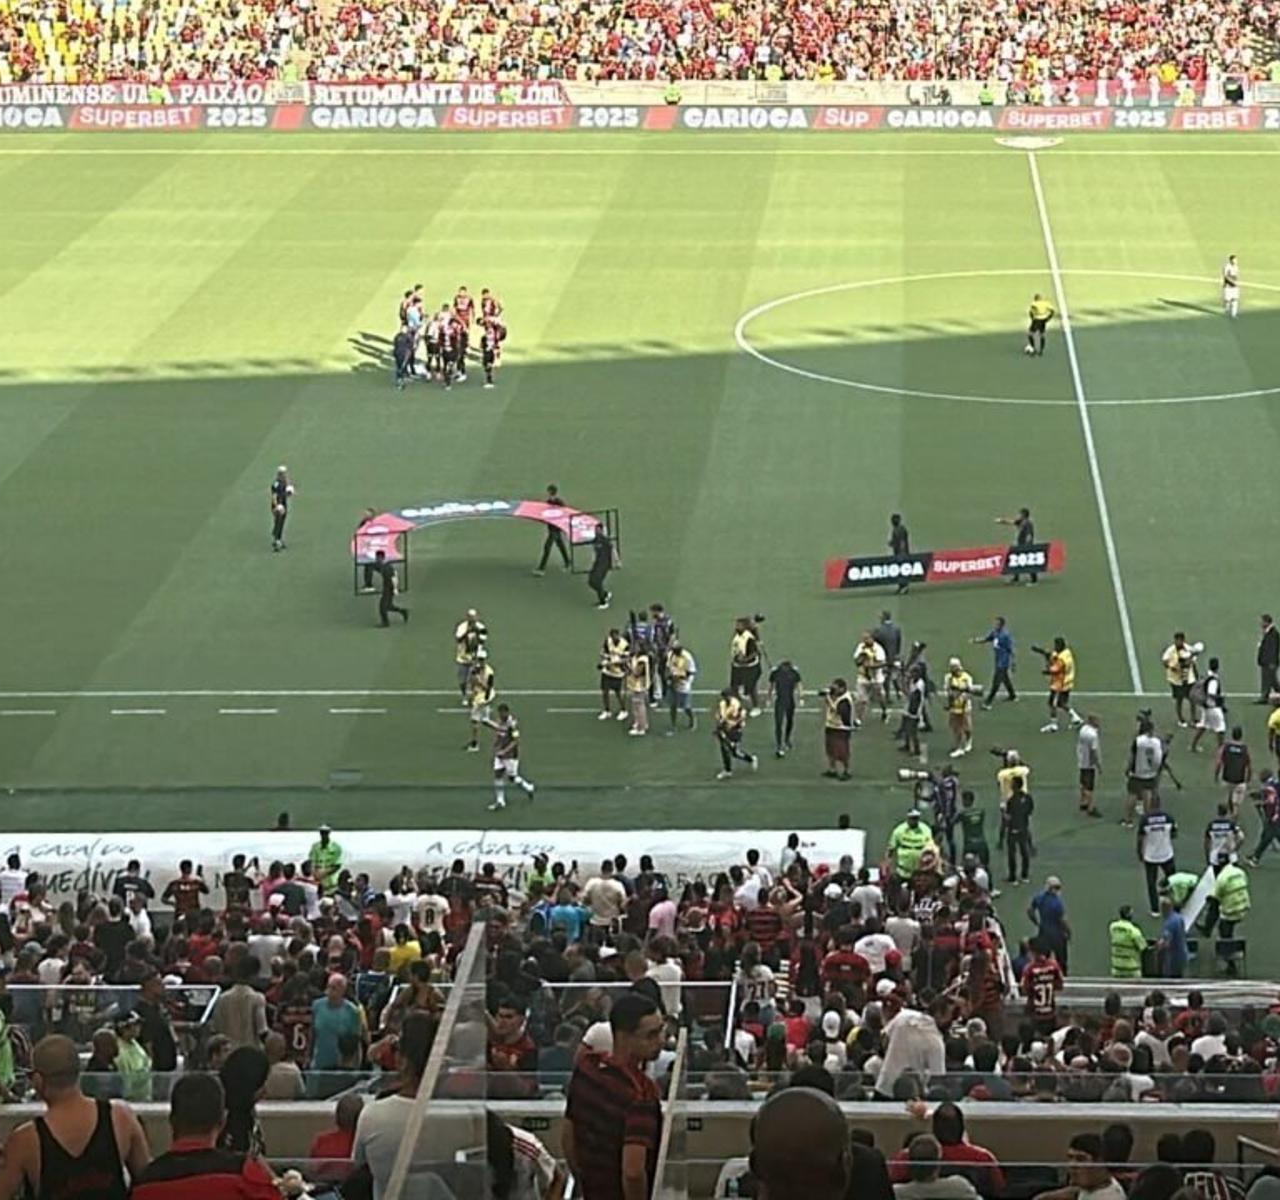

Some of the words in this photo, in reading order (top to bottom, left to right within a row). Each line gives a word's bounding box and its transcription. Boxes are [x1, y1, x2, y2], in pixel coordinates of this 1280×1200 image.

[79, 104, 194, 128] SUPERBET
[206, 106, 267, 128] 2025
[311, 106, 437, 129] CARIOCA
[453, 105, 565, 128] SUPERBET
[578, 106, 639, 129] 2025
[683, 106, 808, 129] CARIOCA
[825, 109, 869, 127] SUP
[887, 108, 993, 129] CARIOCA
[1007, 108, 1104, 129] SUPERBET
[1114, 109, 1167, 128] 2025
[1182, 108, 1249, 129] ERBET
[847, 561, 924, 581] CARIOCA
[933, 554, 1003, 573] SUPERBET
[1008, 550, 1046, 567] 2025
[293, 1023, 306, 1050] 6
